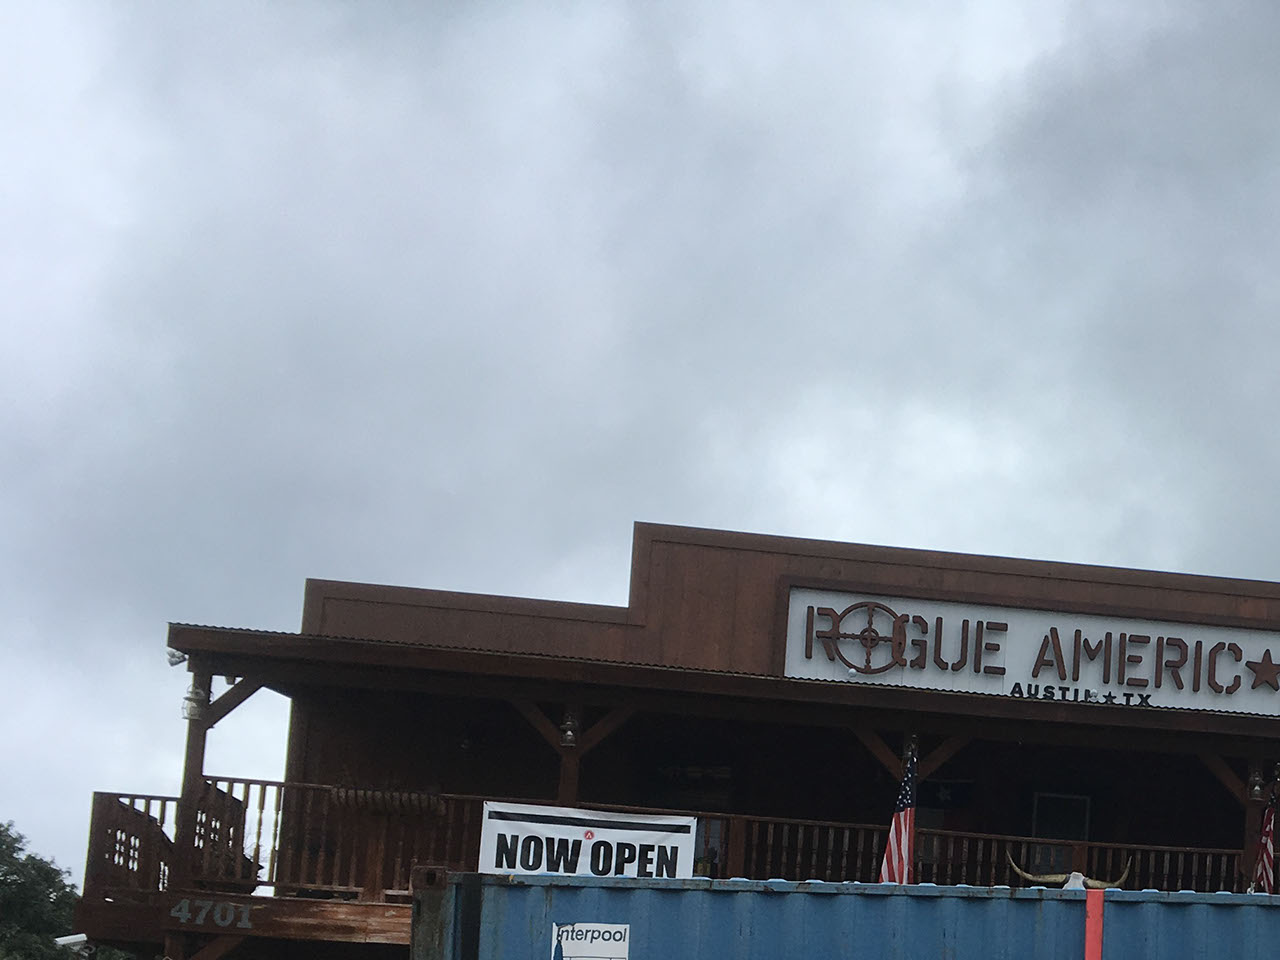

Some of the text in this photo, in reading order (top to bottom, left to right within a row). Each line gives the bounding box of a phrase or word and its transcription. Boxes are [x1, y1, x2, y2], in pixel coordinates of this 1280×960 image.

[804, 602, 1009, 675] ROGUE
[1122, 692, 1152, 706] TX
[494, 833, 679, 879] NOW OPEN
[170, 899, 253, 930] 4701
